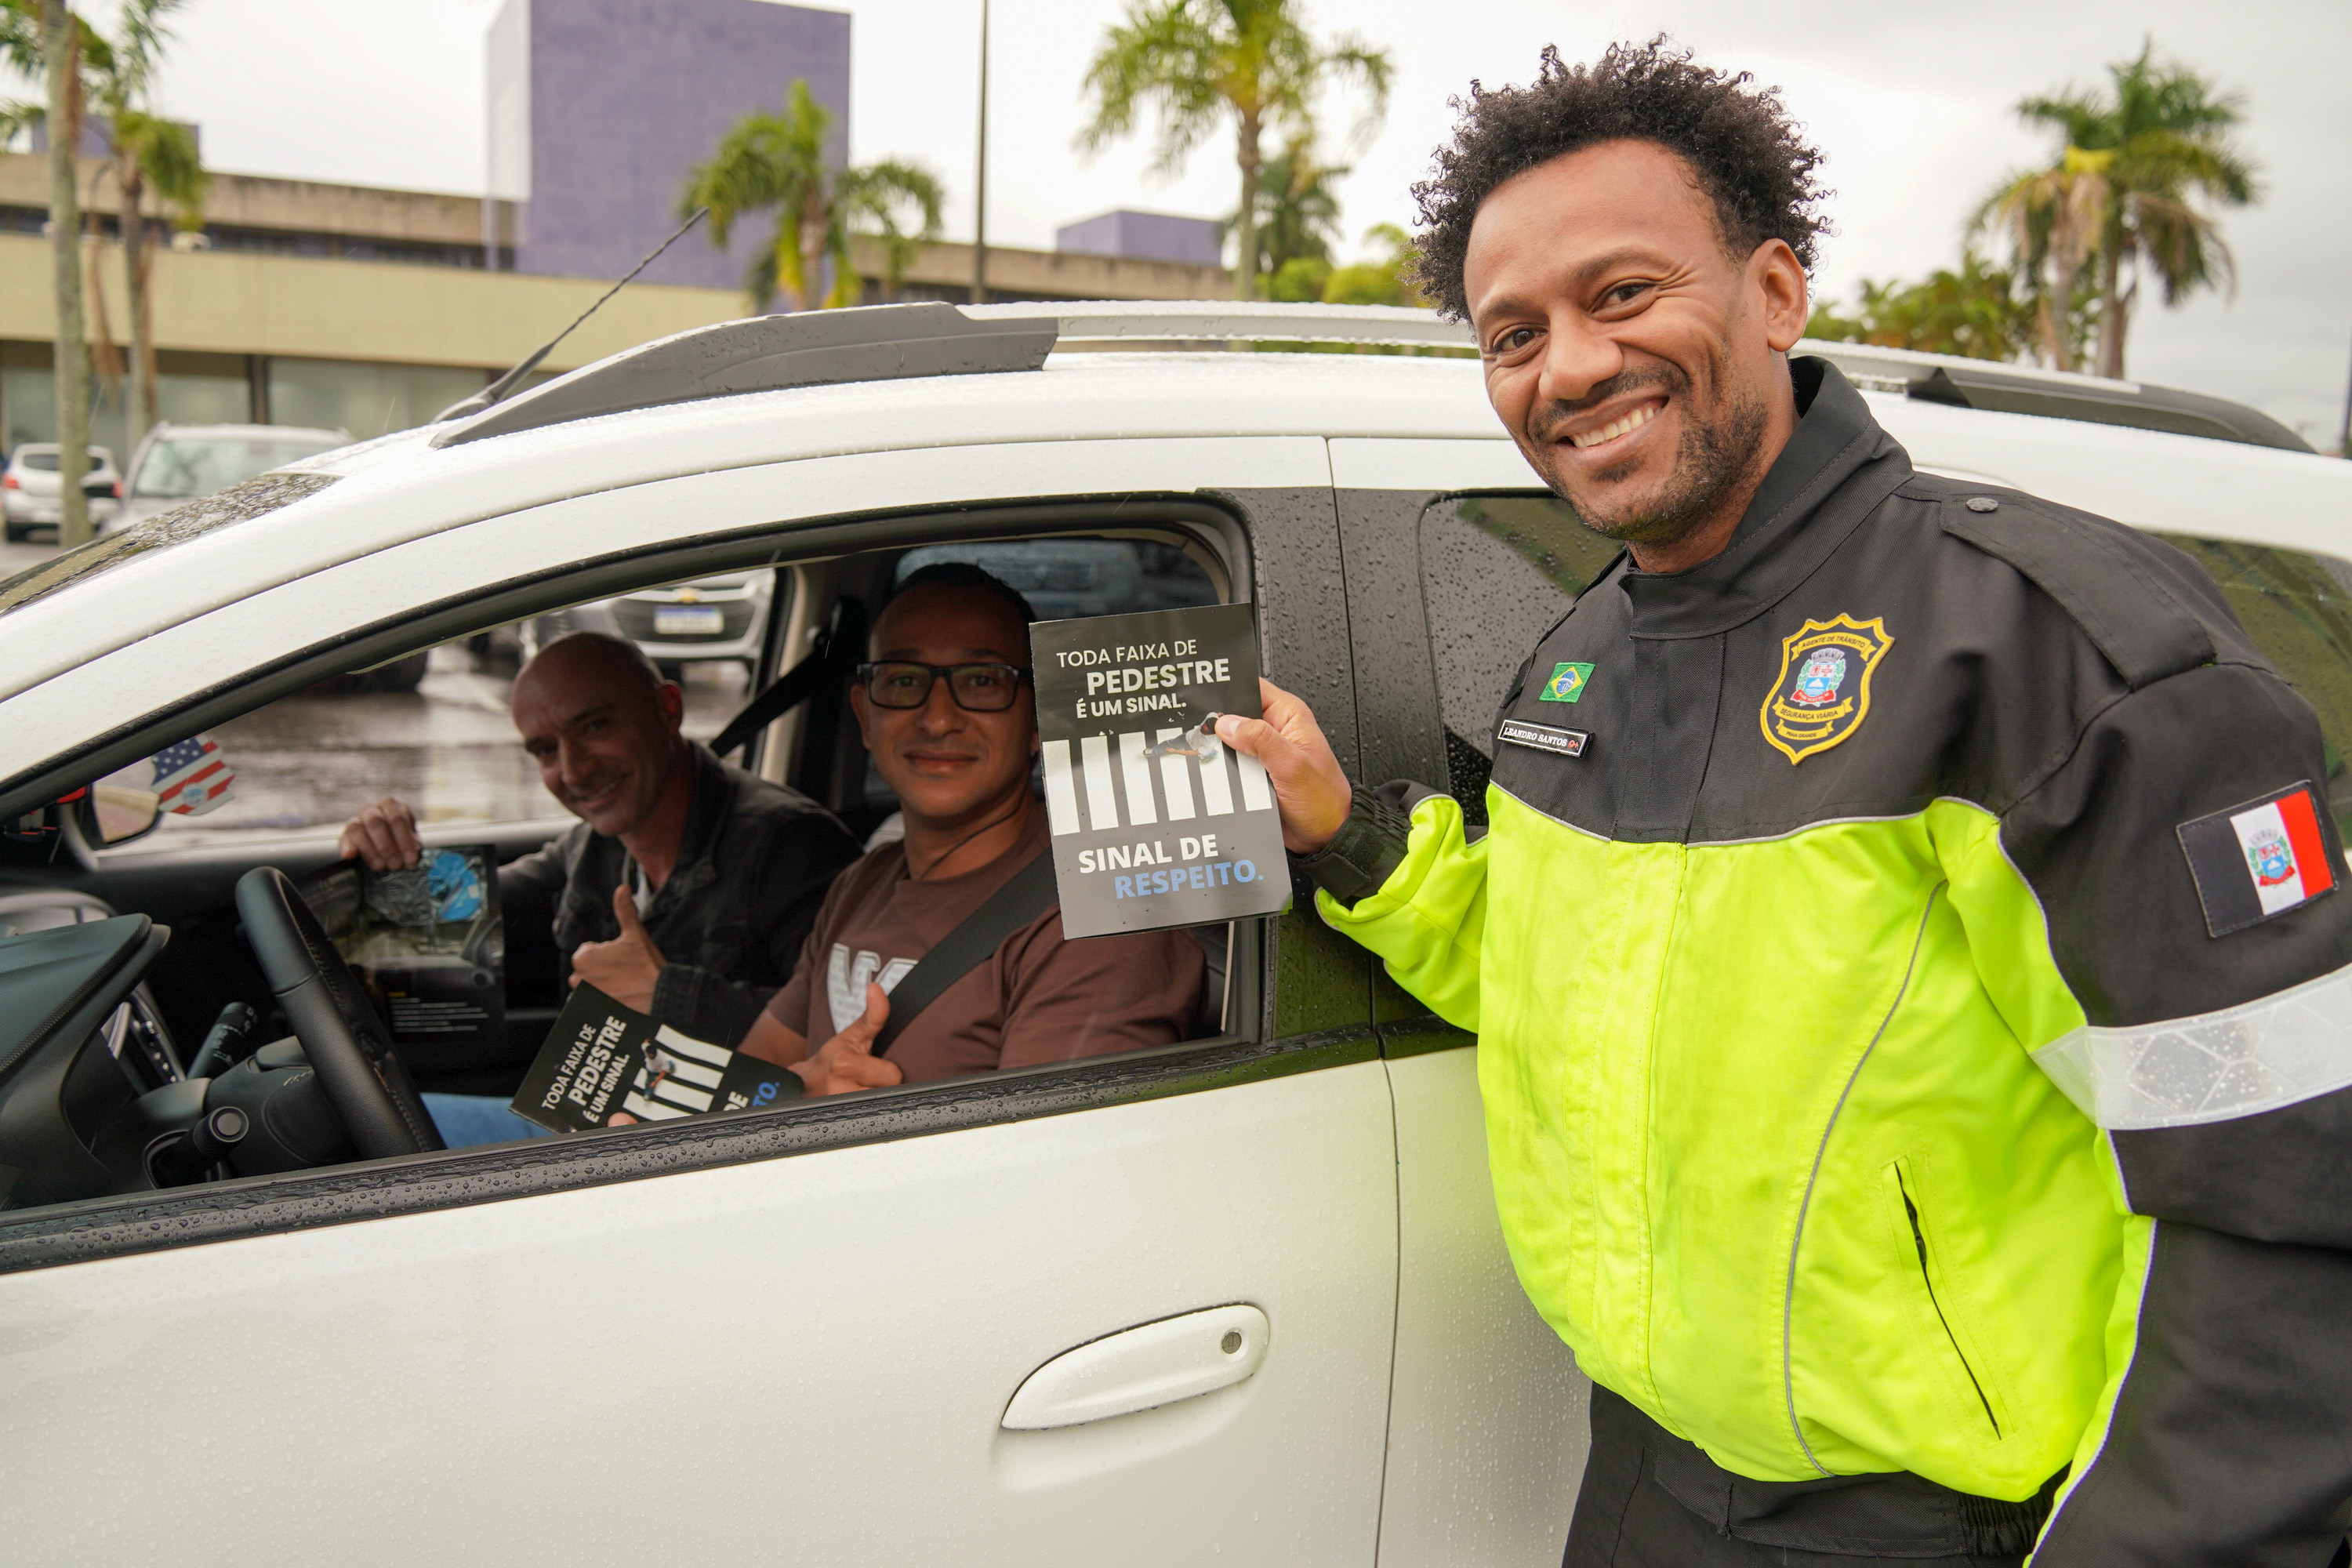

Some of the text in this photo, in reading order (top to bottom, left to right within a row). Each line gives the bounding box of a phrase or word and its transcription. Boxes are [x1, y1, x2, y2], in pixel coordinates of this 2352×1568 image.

[1056, 639, 1197, 668] TODA FAIXA DE
[1802, 637, 1826, 648] AGENTE
[1835, 635, 1866, 648] TRÂNSITO
[1087, 658, 1231, 696] PEDESTRE
[1076, 692, 1187, 719] É UM SINAL.
[1780, 708, 1838, 720] SEGURANÇA VIÁRIA
[1503, 727, 1537, 741] LEANDRO
[1537, 734, 1568, 747] SANTOS
[1078, 833, 1219, 874] SINAL DE
[1113, 859, 1265, 899] RESPEITO.
[541, 1022, 597, 1110] TODA FAIXA DE
[567, 1014, 627, 1107] PEDESTRE
[582, 1053, 631, 1123] É UM SINAL.
